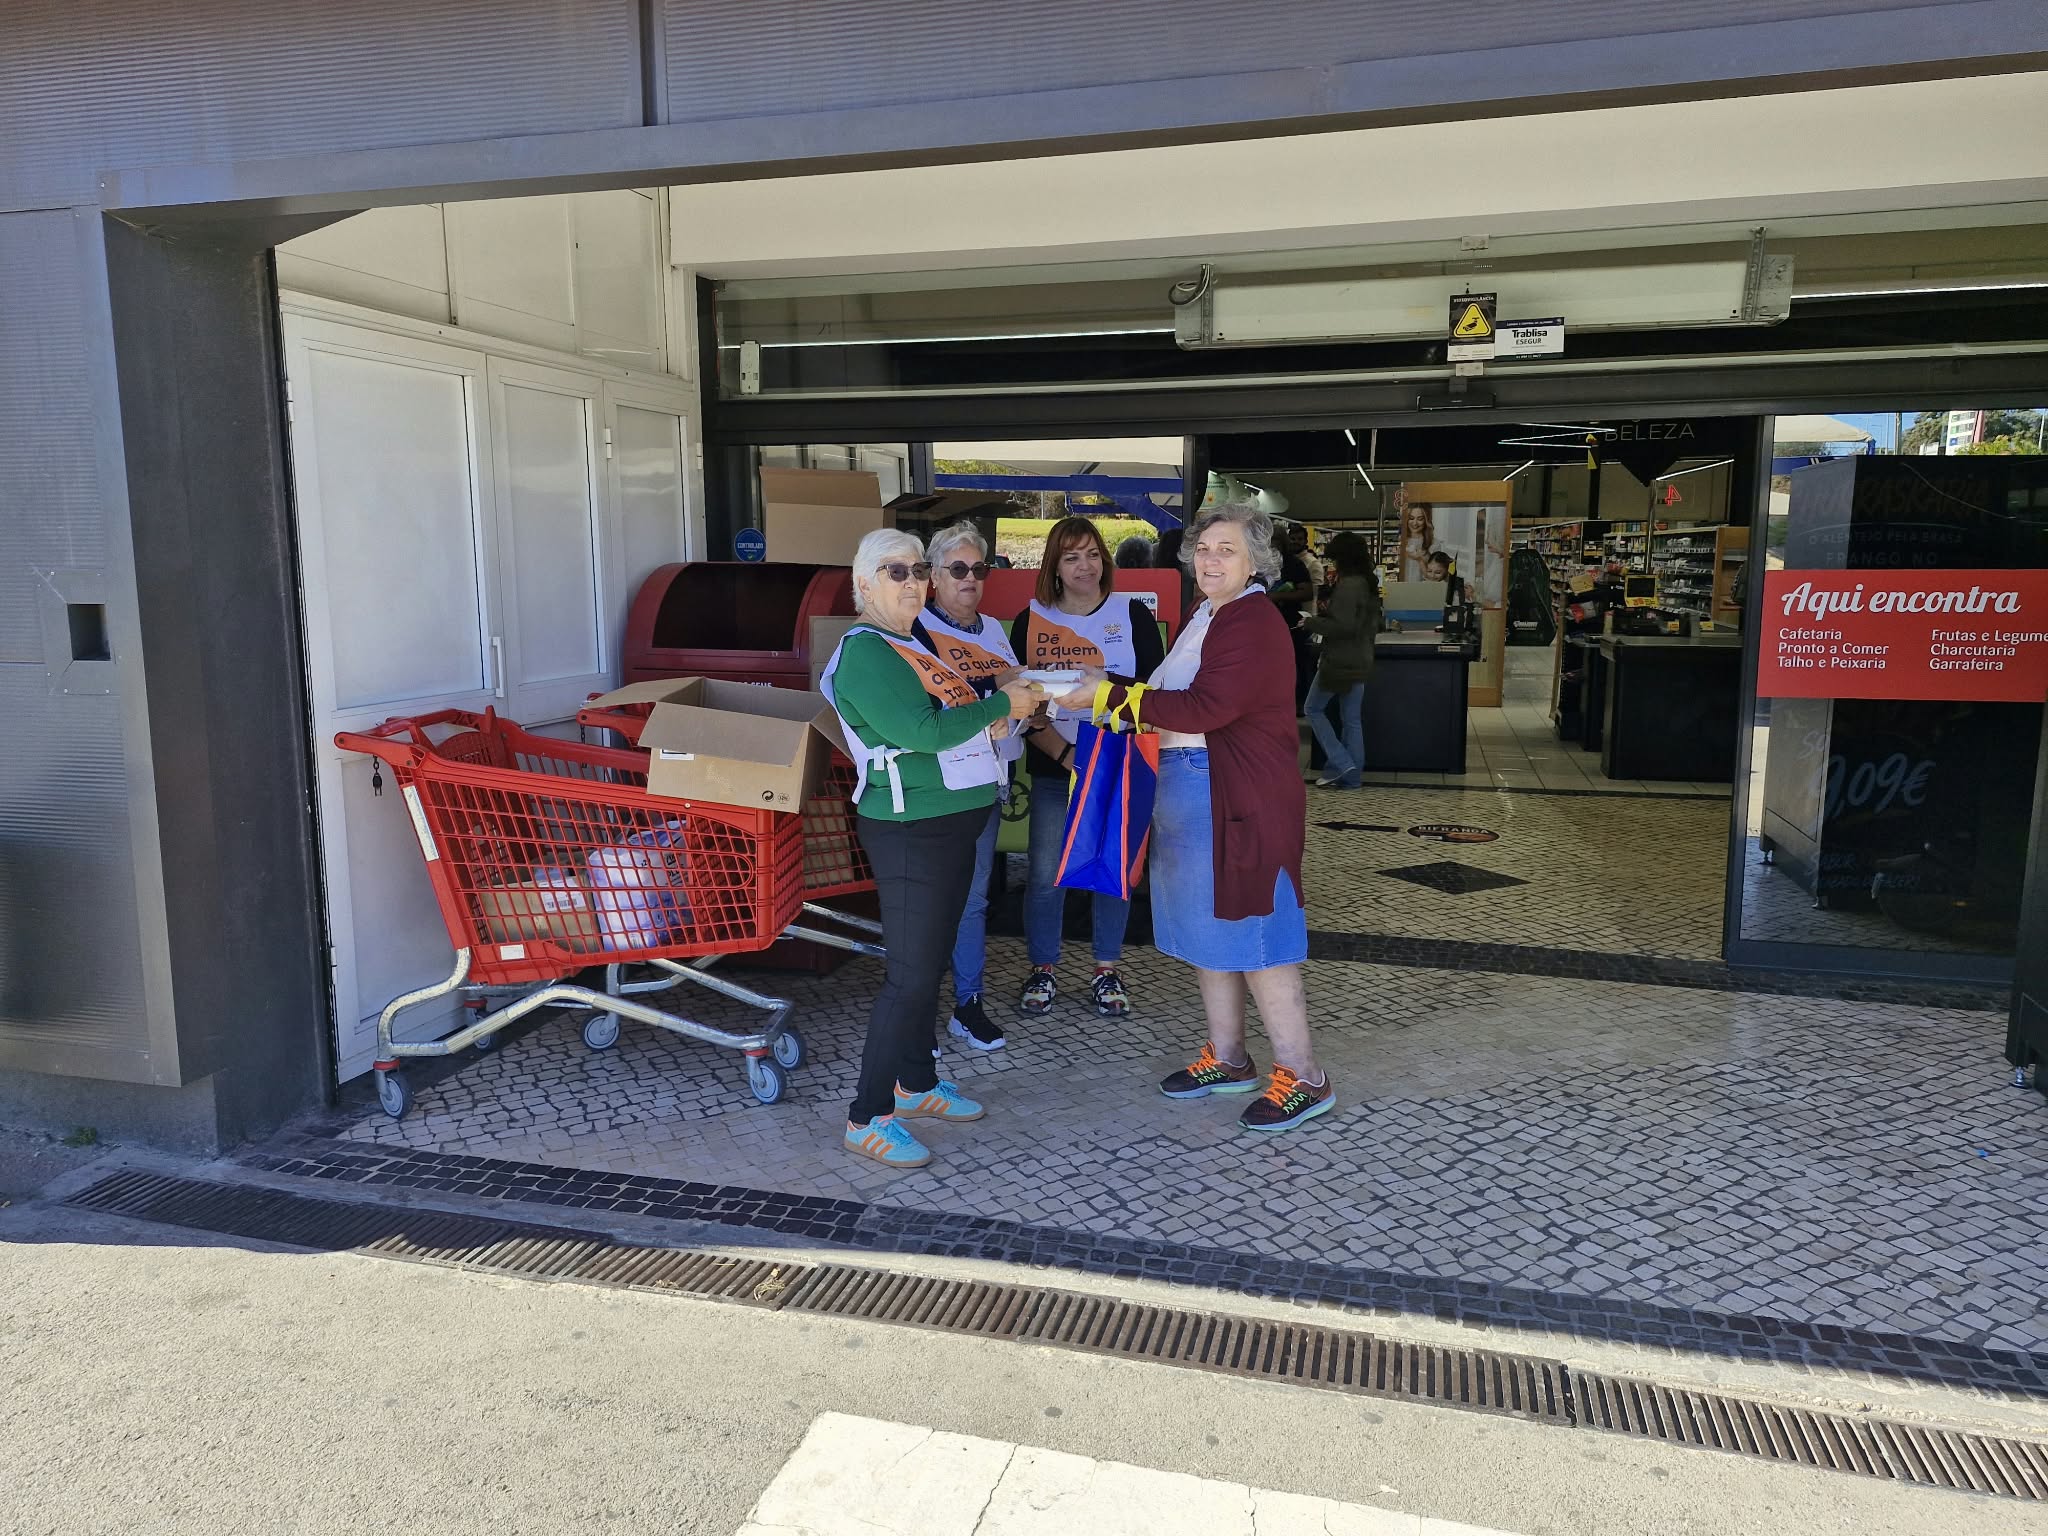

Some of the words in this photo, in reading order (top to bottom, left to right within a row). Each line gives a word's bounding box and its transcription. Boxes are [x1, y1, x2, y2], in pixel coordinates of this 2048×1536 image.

[1512, 328, 1548, 338] Trablisa
[1604, 423, 1695, 441] BELEZA
[1826, 551, 1901, 566] FRANGO
[1912, 551, 1938, 566] NO
[1781, 582, 1864, 621] Aqui
[1868, 586, 2021, 613] encontra
[1038, 633, 1060, 645] Dê
[1779, 628, 1842, 640] Cafetaria
[1931, 629, 1977, 641] Frutas
[1981, 632, 1990, 641] e
[949, 646, 973, 661] Dê
[1036, 647, 1047, 657] a
[1051, 645, 1098, 661] quem
[1778, 642, 1825, 654] Pronto
[1829, 645, 1838, 654] a
[1842, 643, 1889, 655] Comer
[1930, 643, 2016, 656] Charcutaria
[958, 661, 971, 671] a
[971, 659, 1012, 673] quem
[1037, 659, 1083, 671] tnt
[1777, 656, 1814, 668] Talho
[1818, 658, 1826, 668] e
[1831, 657, 1886, 669] Peixaria
[1929, 658, 2004, 671] Garrafeira
[931, 673, 946, 685] a
